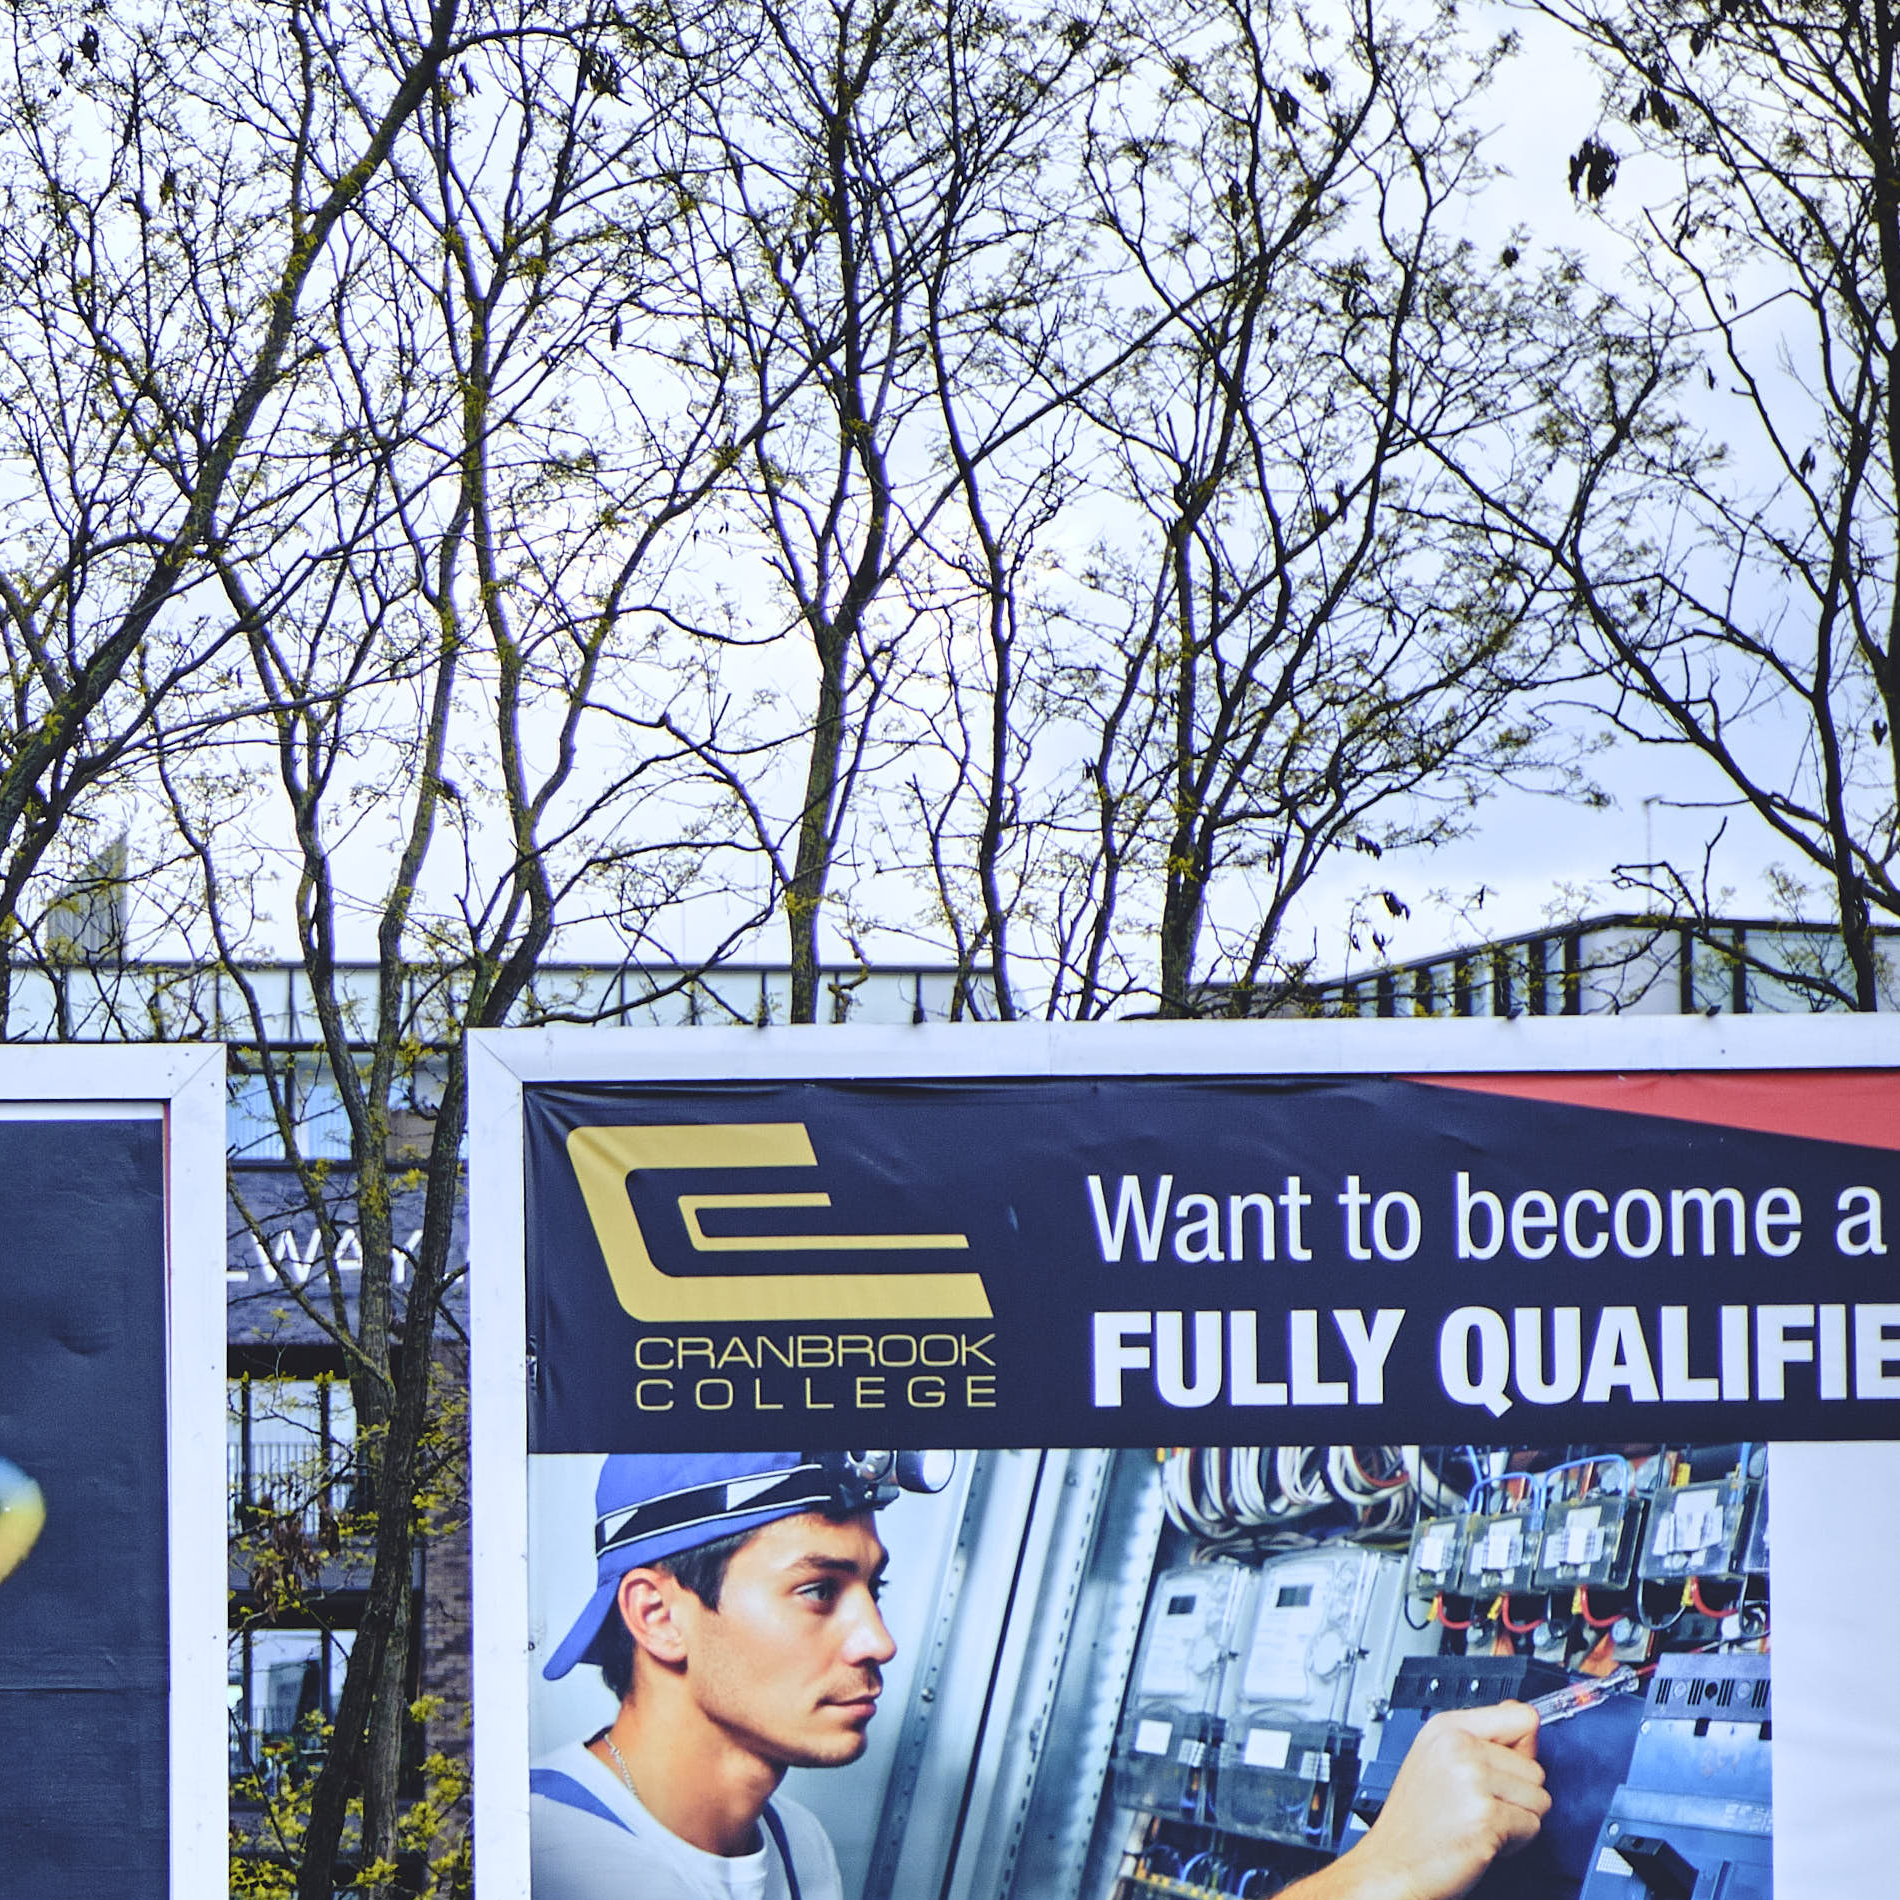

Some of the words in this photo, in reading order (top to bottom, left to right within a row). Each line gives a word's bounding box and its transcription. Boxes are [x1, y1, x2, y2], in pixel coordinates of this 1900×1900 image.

[1087, 1174, 1312, 1263] Want
[1338, 1174, 1422, 1260] to
[1456, 1171, 1803, 1259] become
[1835, 1186, 1887, 1256] a
[635, 1333, 997, 1371] CRANBROOK
[1092, 1308, 1406, 1407] FULLY
[1439, 1303, 1900, 1418] QUALIFIE
[635, 1375, 997, 1411] COLLEGE
